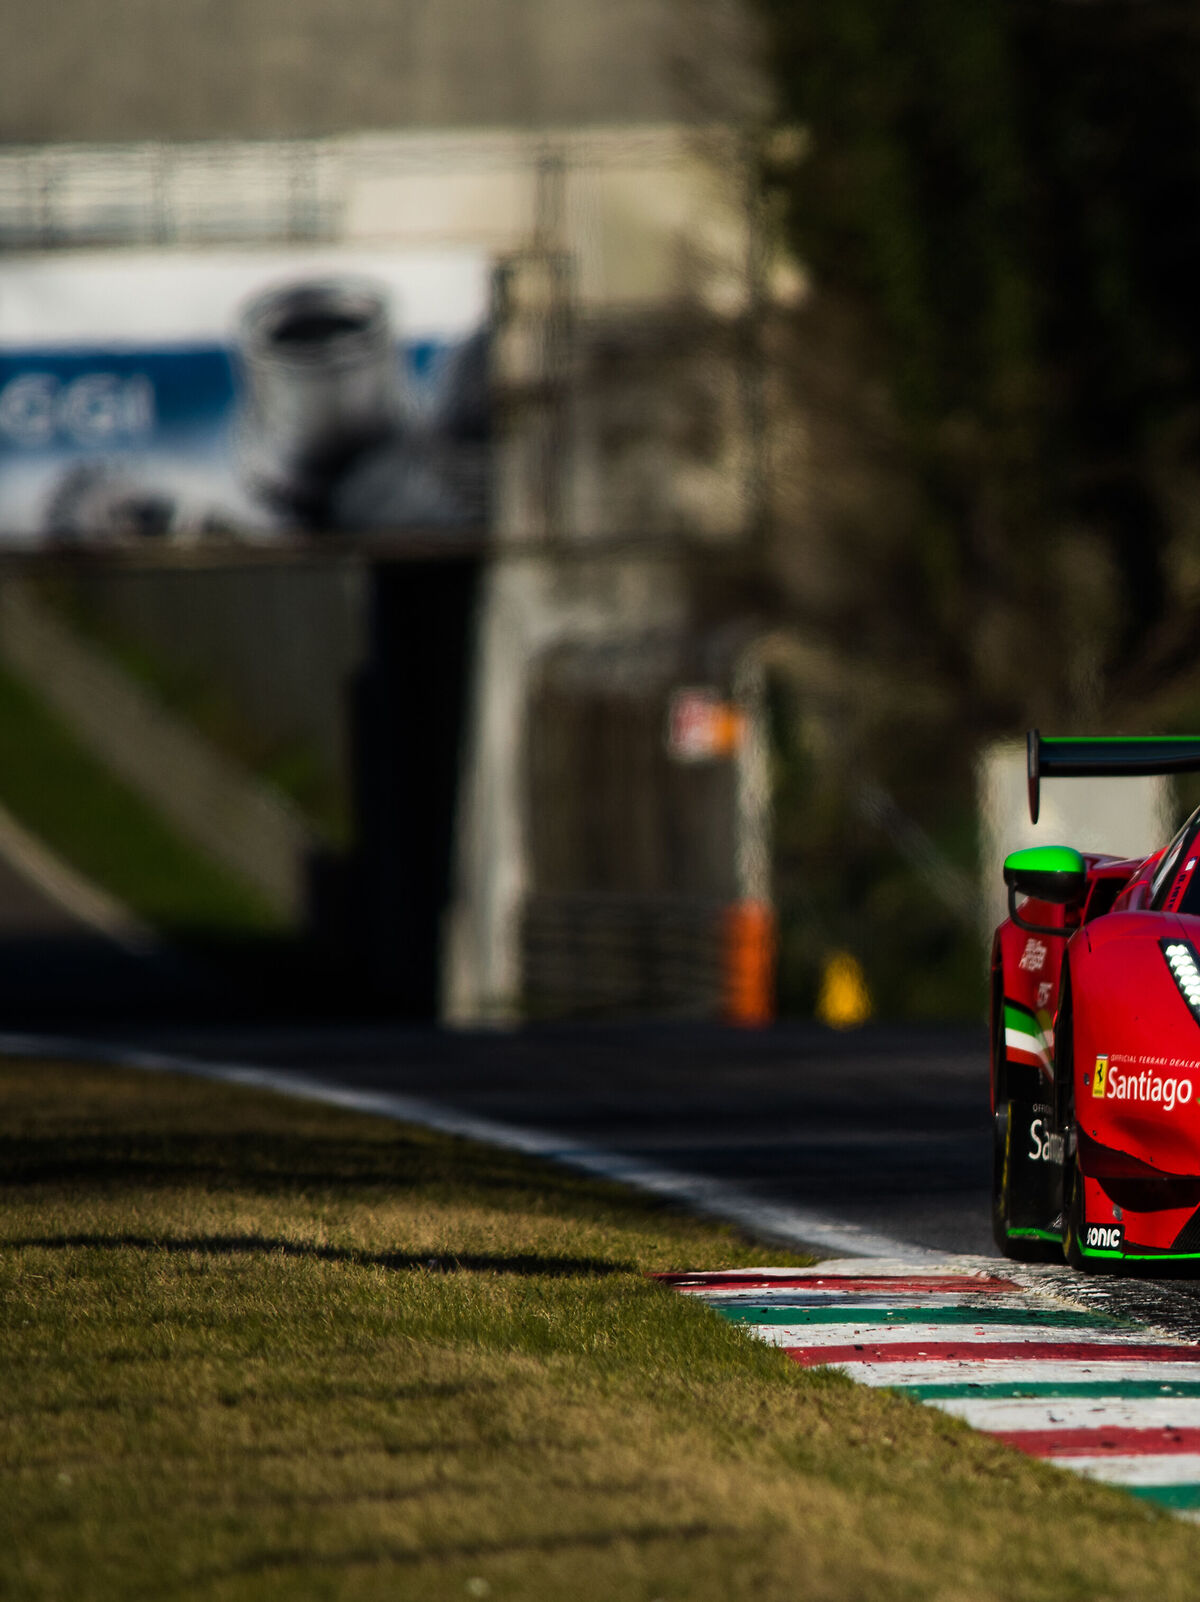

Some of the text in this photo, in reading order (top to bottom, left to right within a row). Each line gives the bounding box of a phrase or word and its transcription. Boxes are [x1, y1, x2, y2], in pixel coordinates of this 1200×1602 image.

[1110, 1054, 1200, 1069] OFFICIAL FERRARI DEALER
[1107, 1066, 1193, 1111] Santiago
